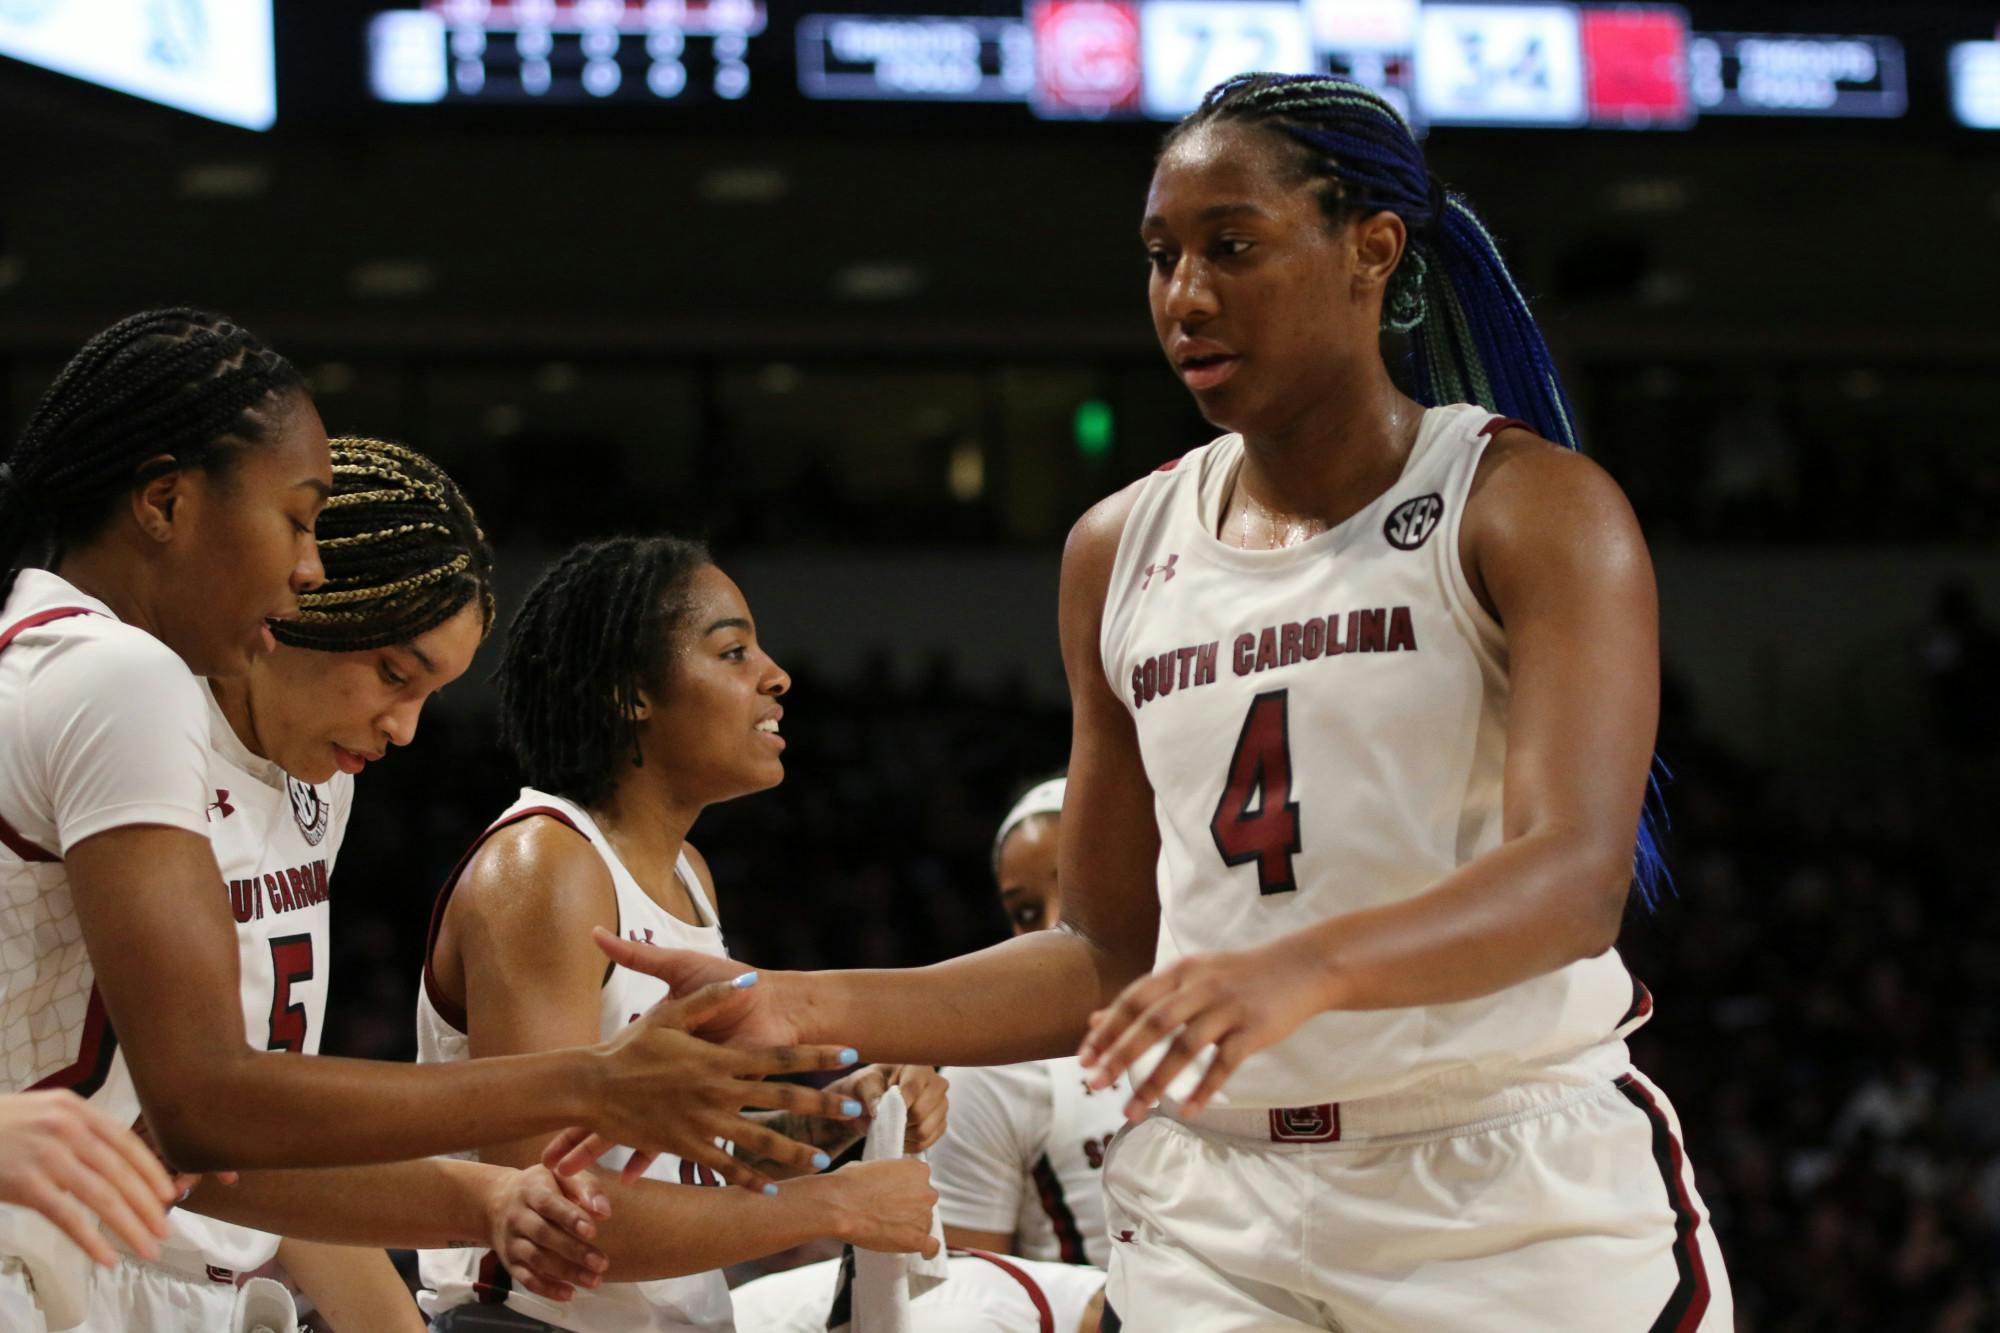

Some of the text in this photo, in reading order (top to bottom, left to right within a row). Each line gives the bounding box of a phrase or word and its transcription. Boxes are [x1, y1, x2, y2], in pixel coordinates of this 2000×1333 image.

[1389, 496, 1440, 546] SEC
[1131, 605, 1418, 710] SOUTH CAROLINA
[1209, 687, 1303, 897] 4
[267, 932, 313, 1054] 5
